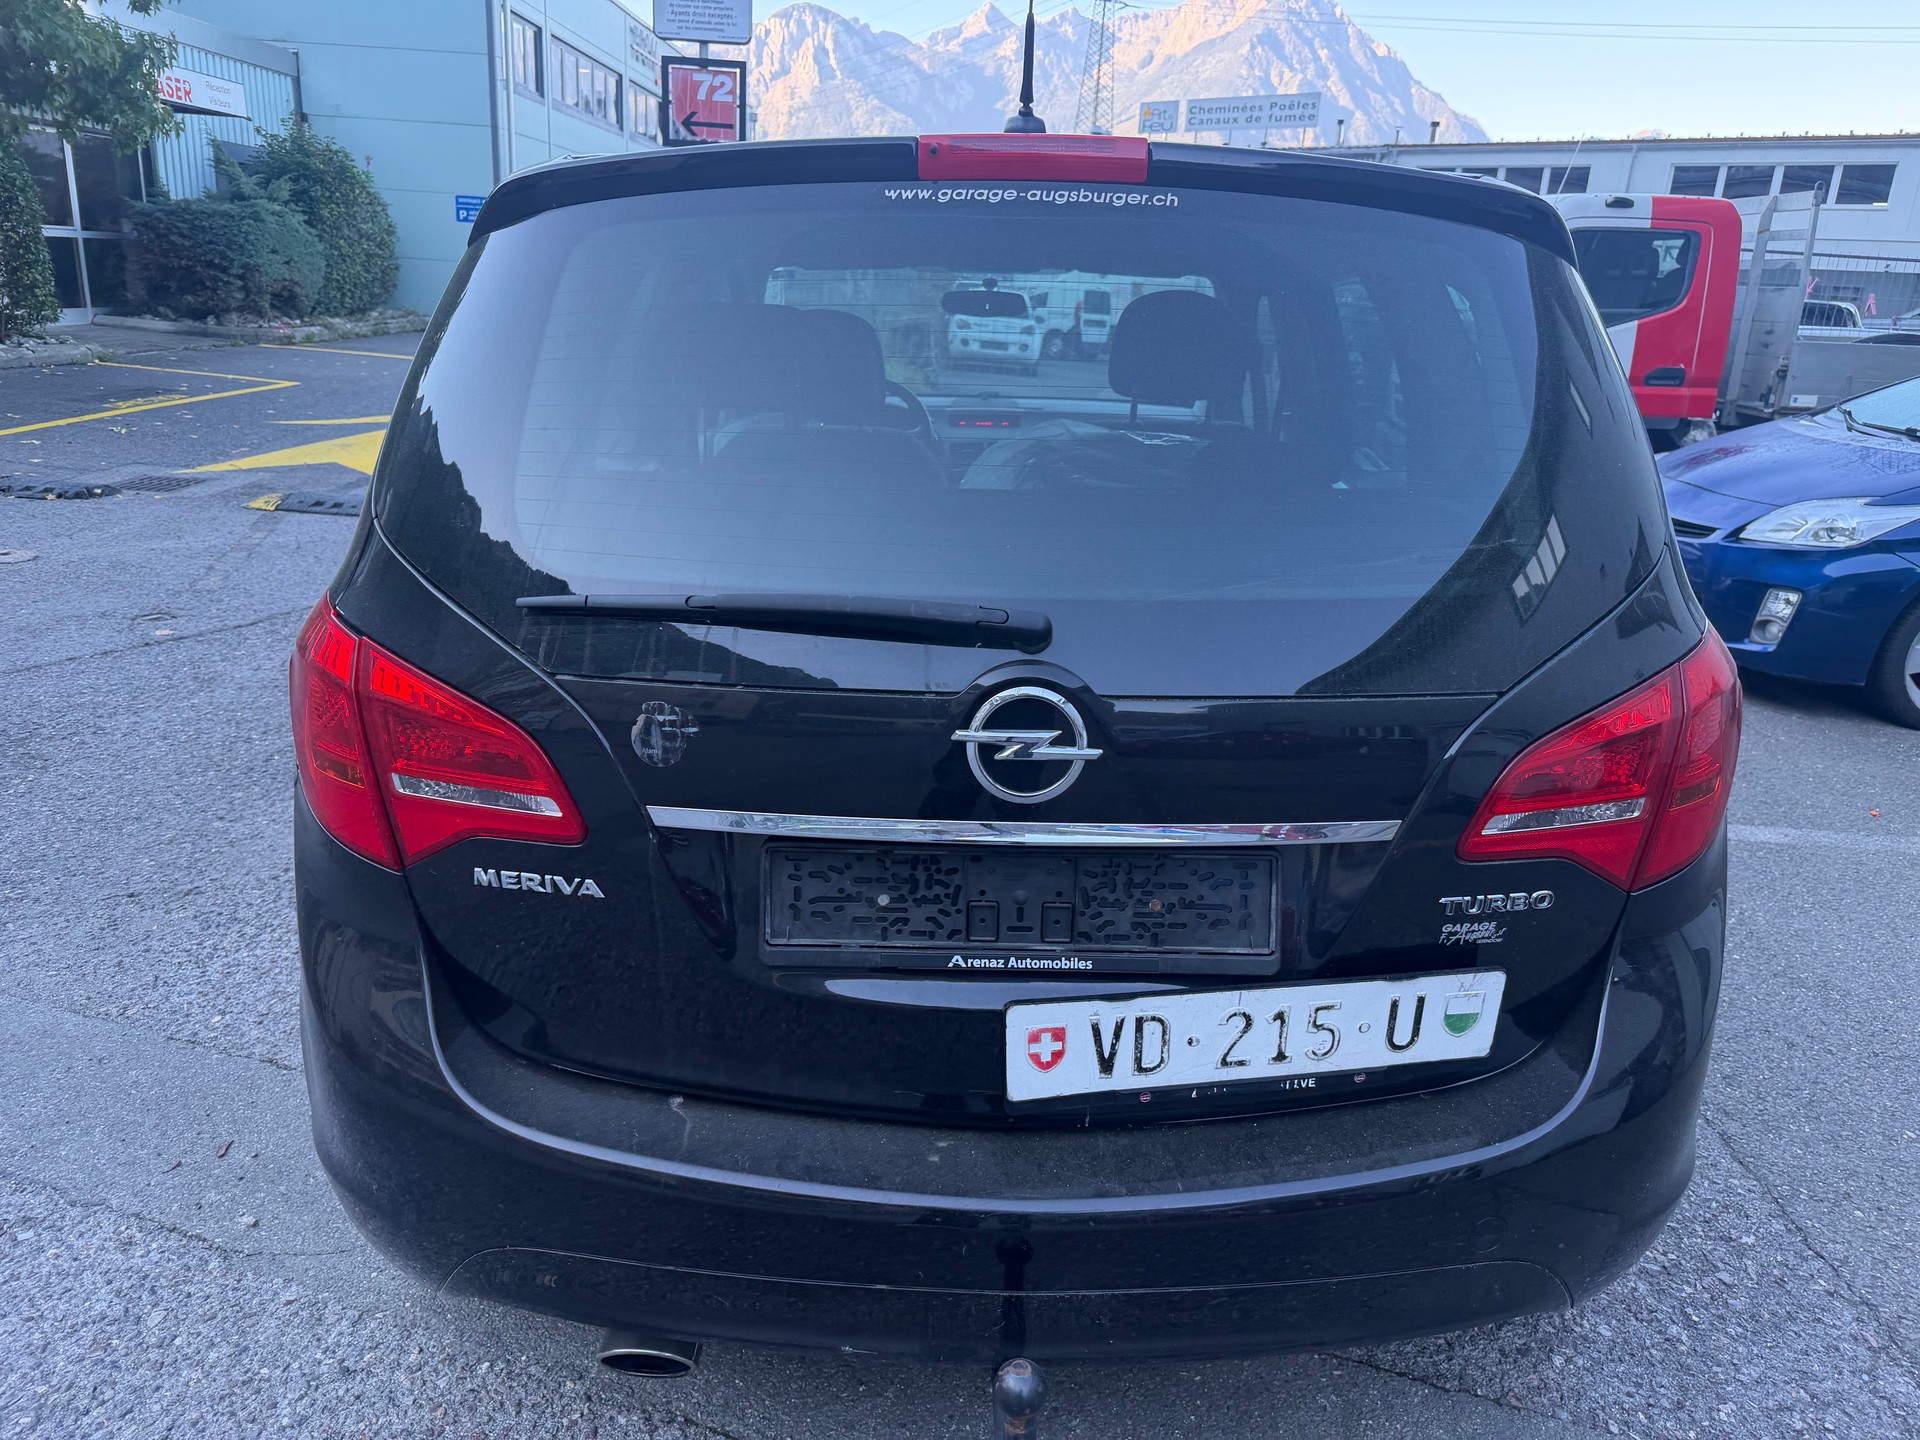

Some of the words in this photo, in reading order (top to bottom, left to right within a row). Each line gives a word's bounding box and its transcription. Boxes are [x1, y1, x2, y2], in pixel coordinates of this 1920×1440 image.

[670, 9, 690, 17] Ayants
[707, 12, 734, 20] exceptés
[692, 72, 733, 102] 72
[1189, 101, 1263, 116] Cheminées
[1269, 99, 1317, 112] Poêles
[1188, 116, 1239, 126] Canaux
[1245, 114, 1262, 124] de
[1268, 112, 1316, 123] fumée
[884, 187, 1179, 207] www.garage-augsburger.ch
[473, 867, 606, 898] MERIVA
[1439, 889, 1555, 916] TURBO
[1441, 921, 1498, 933] GARAGE
[948, 955, 1005, 968] Arenaz
[1007, 956, 1093, 970] Automobiles
